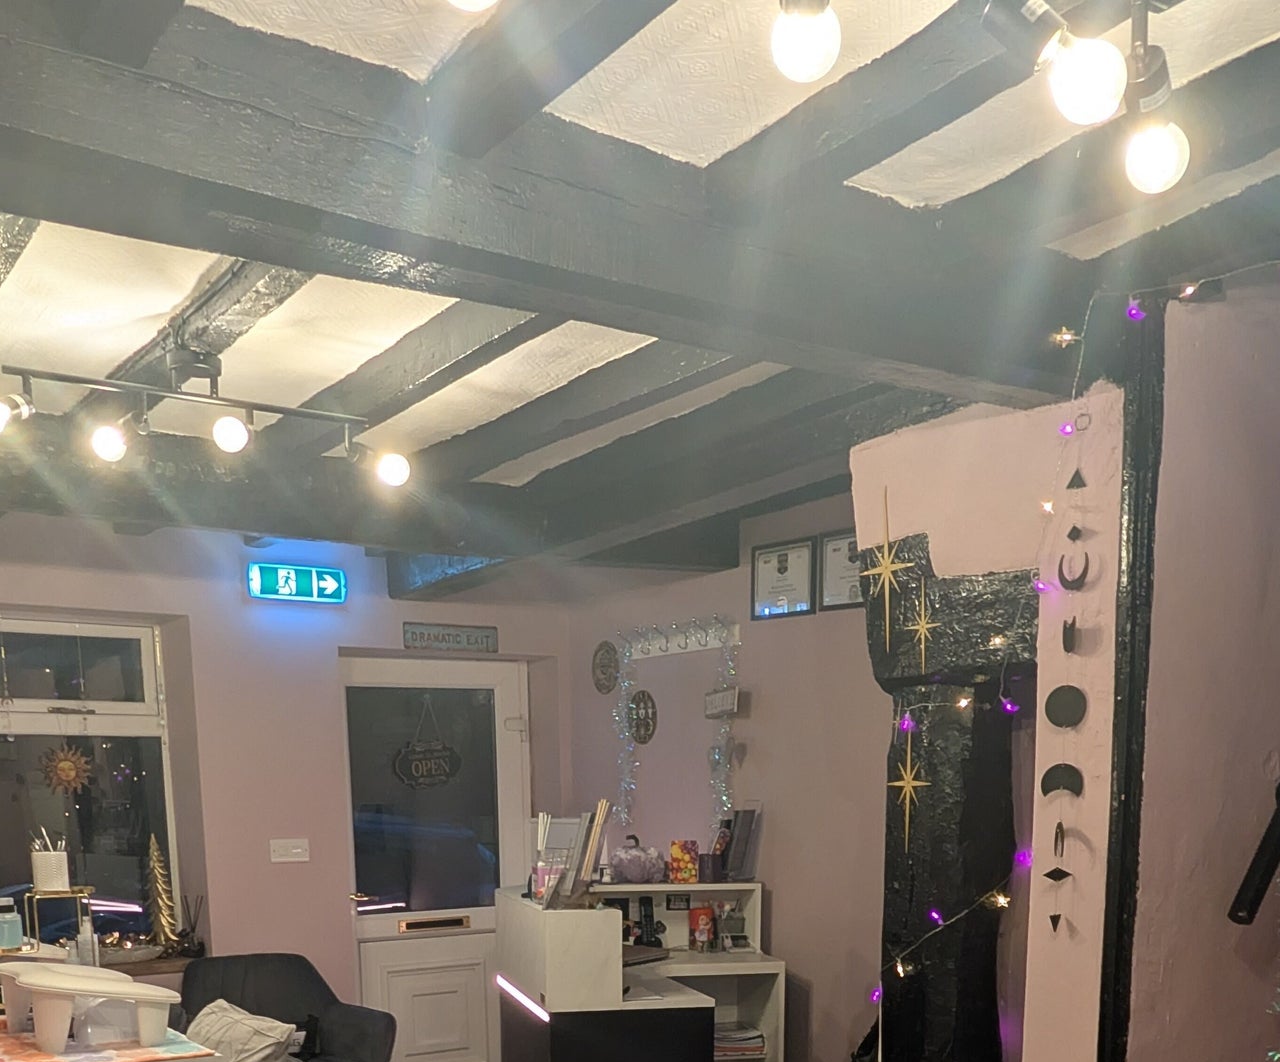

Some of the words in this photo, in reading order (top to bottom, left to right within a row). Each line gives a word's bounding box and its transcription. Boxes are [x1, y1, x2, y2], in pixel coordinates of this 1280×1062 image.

[410, 631, 462, 645] DRAMATIC
[466, 634, 491, 647] EXIT
[411, 759, 450, 777] OPEN
